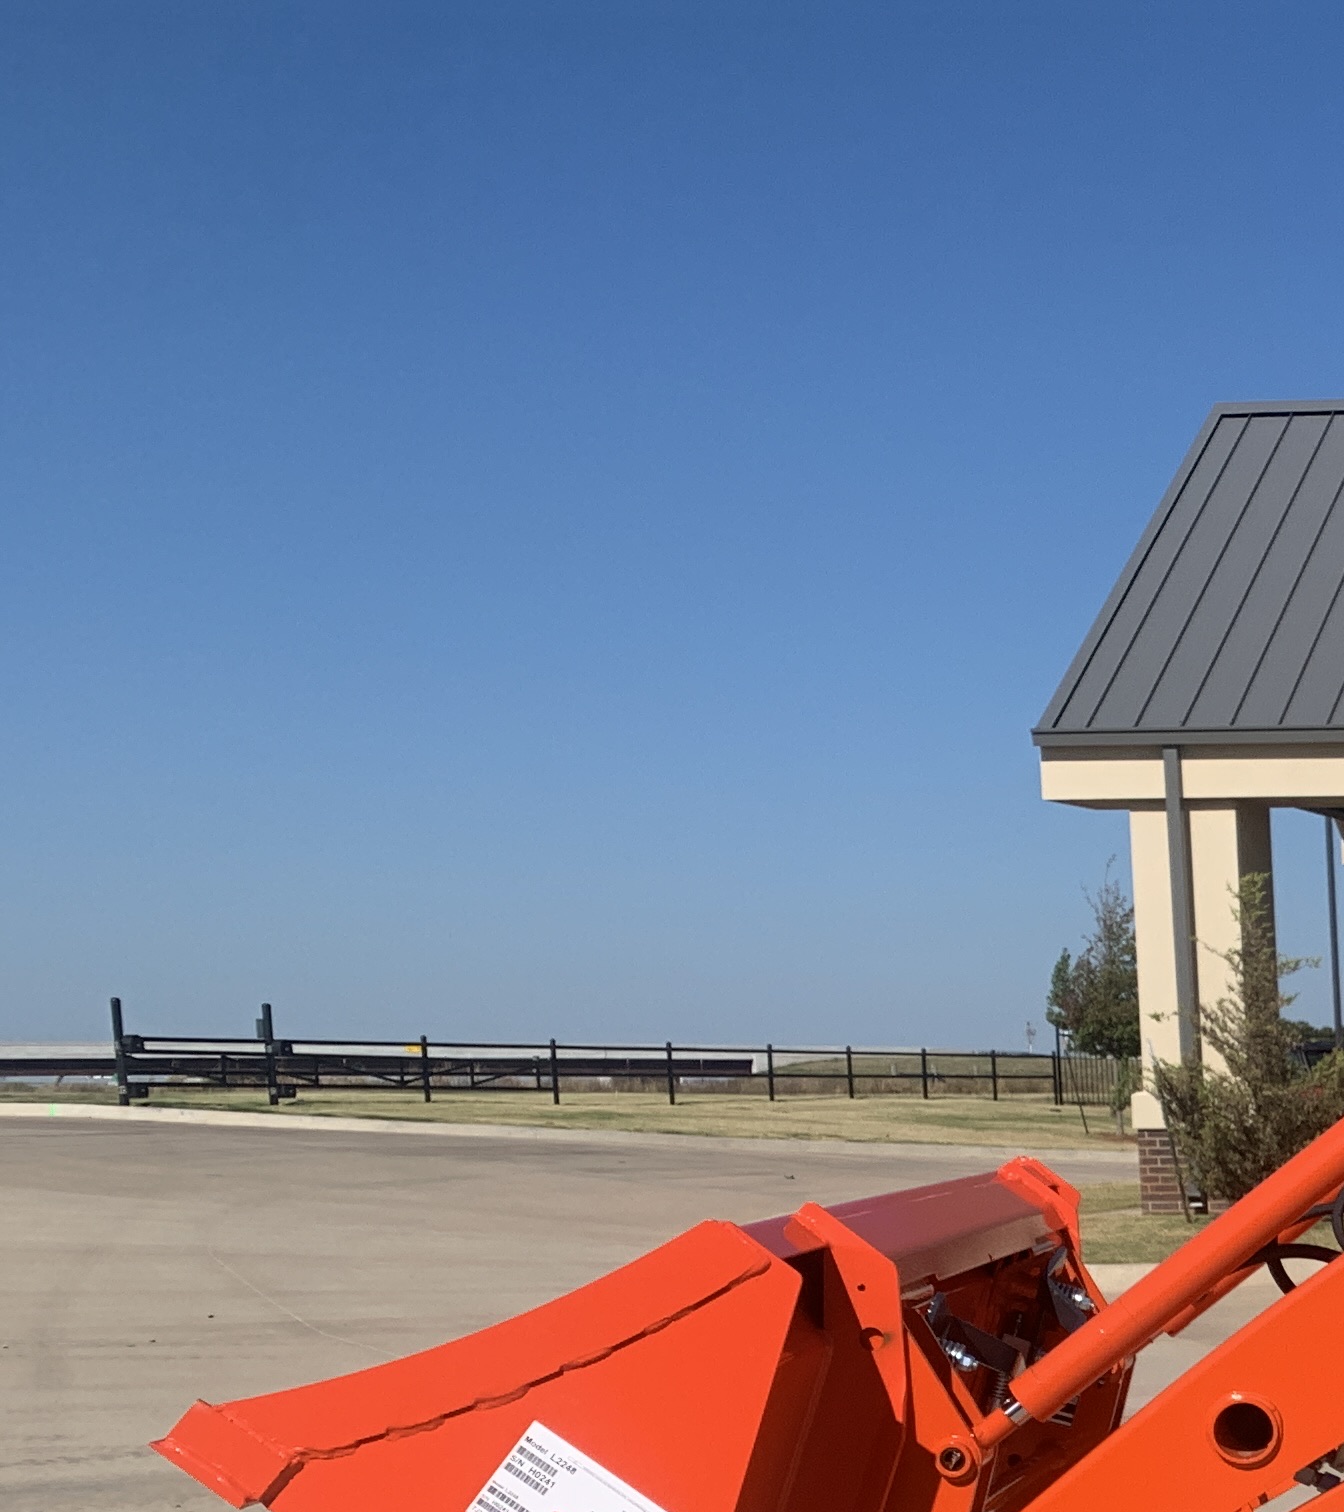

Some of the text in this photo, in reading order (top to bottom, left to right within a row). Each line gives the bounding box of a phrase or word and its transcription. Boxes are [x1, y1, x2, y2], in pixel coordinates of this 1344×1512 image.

[524, 1436, 549, 1456] Model
[510, 1455, 556, 1489] S/N H0241
